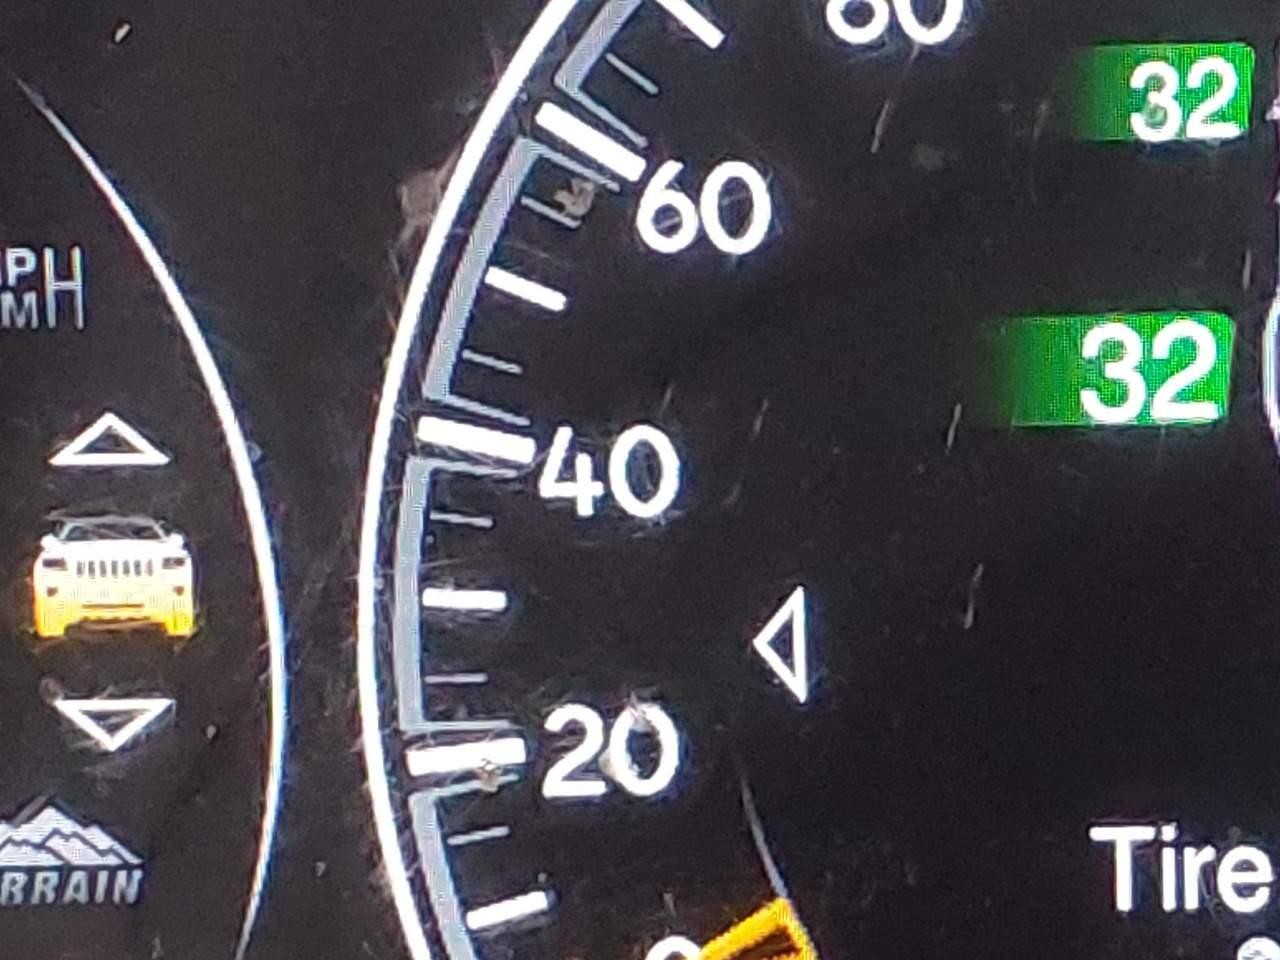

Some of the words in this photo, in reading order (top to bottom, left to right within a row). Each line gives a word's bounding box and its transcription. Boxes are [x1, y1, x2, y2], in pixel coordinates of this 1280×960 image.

[1129, 57, 1240, 143] 32
[635, 159, 772, 255] 60
[1080, 320, 1219, 424] 32
[538, 424, 681, 518] 40
[542, 703, 680, 798] 20
[1088, 822, 1275, 914] Tire
